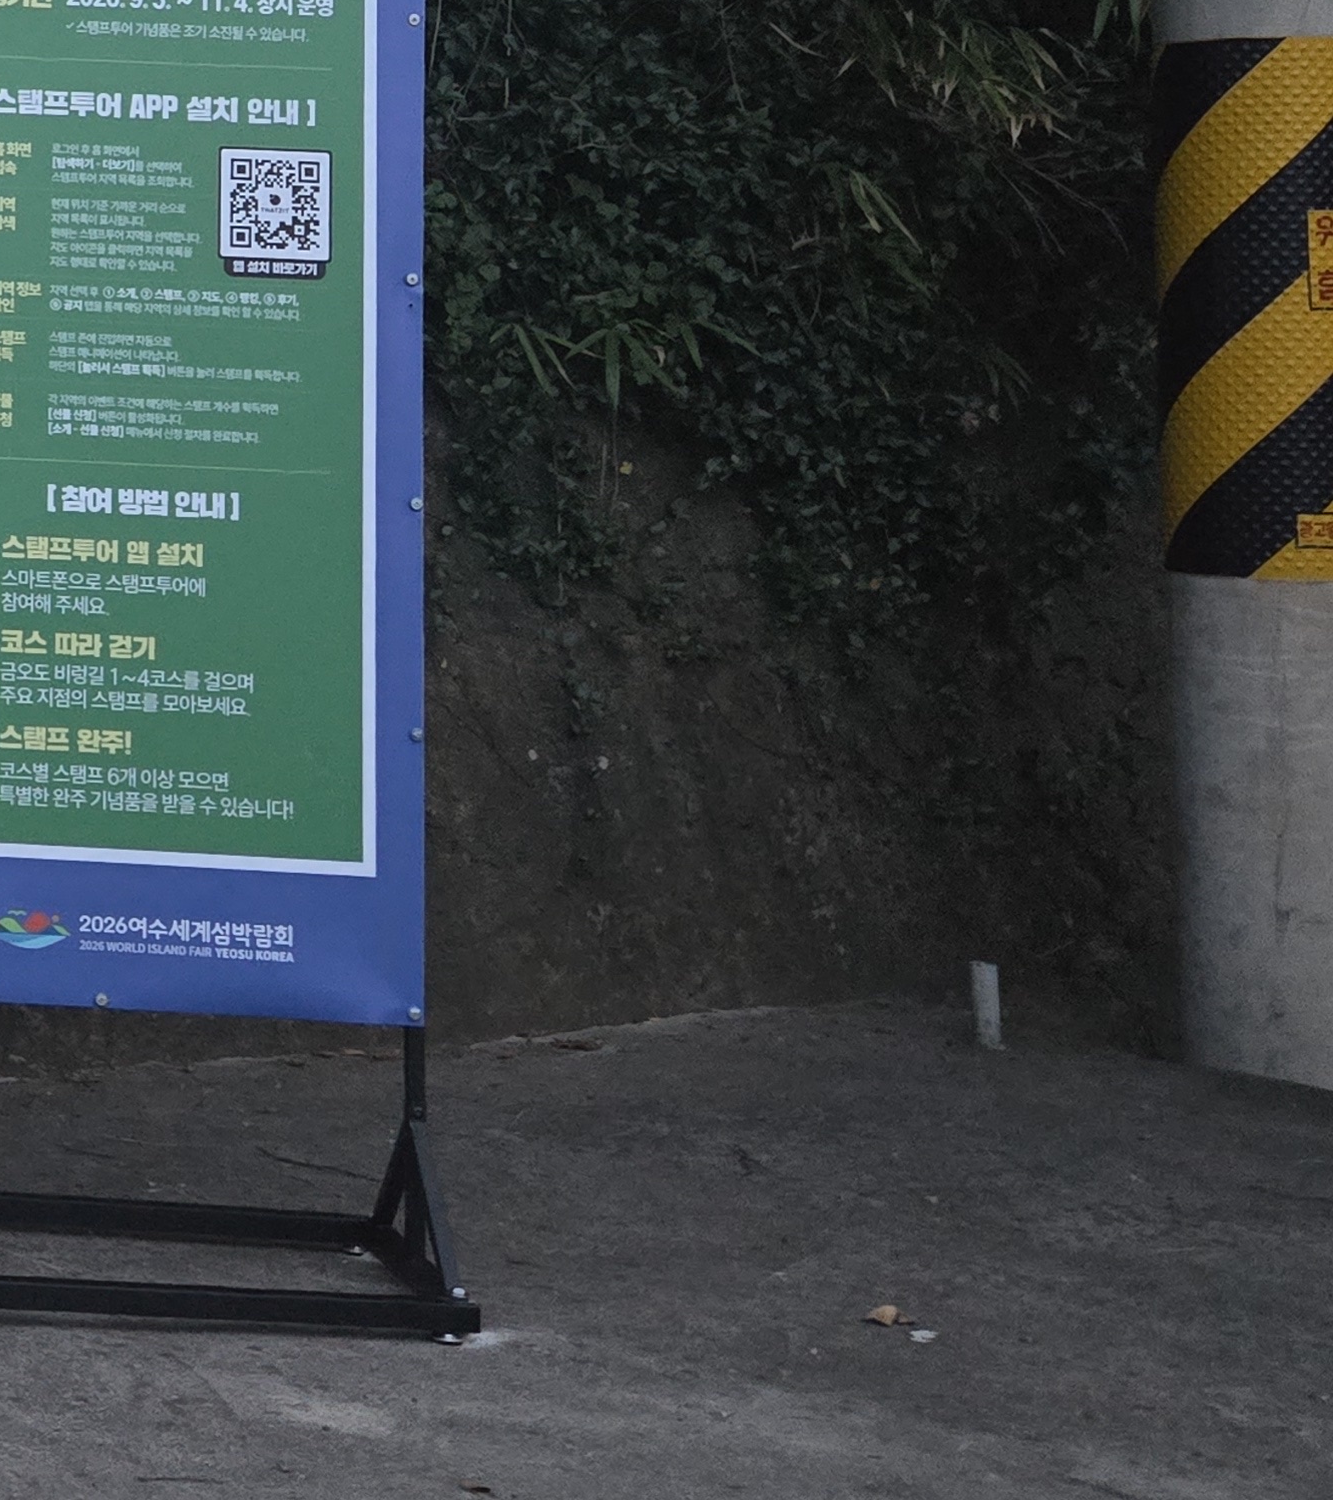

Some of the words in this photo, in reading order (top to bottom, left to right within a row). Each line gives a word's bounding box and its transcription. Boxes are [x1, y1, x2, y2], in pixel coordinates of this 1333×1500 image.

[130, 95, 178, 119] APP
[187, 96, 238, 123] 설치
[247, 98, 298, 125] 안내
[248, 261, 269, 273] 설치
[16, 282, 42, 297] 정보
[62, 485, 112, 514] 참여
[118, 488, 168, 516] 방법
[175, 491, 226, 519] 안내
[1, 535, 118, 563] 스탬프투어
[127, 541, 149, 565] 앱
[157, 542, 203, 567] 설치
[1, 569, 101, 590] 스마트폰으로
[1, 592, 51, 614] 참여해
[55, 595, 109, 616] 주세요.
[1, 630, 47, 655] 코스
[55, 633, 102, 657] 따라
[109, 635, 156, 659] 걷기
[0, 663, 51, 681] 금오도
[55, 665, 105, 684] 비렁길
[204, 671, 254, 693] 걸으며
[0, 687, 32, 706] 주요
[37, 688, 87, 709] 지점의
[91, 691, 158, 712] 스탬프를
[163, 694, 250, 716] 모아보세요.
[0, 725, 69, 751] 스탬프
[77, 729, 131, 755] 완주!
[0, 763, 49, 782] 코스별
[53, 765, 103, 785] 스탬프
[108, 767, 136, 786] 6개
[141, 768, 174, 788] 이상
[178, 770, 228, 791] 모으면
[54, 788, 86, 808] 완주
[90, 789, 158, 812] 기념품을
[162, 792, 195, 814] 받을
[200, 796, 217, 814] 수
[221, 797, 294, 819] 있습니다!
[79, 915, 293, 948] 2026여수세계섬박람회
